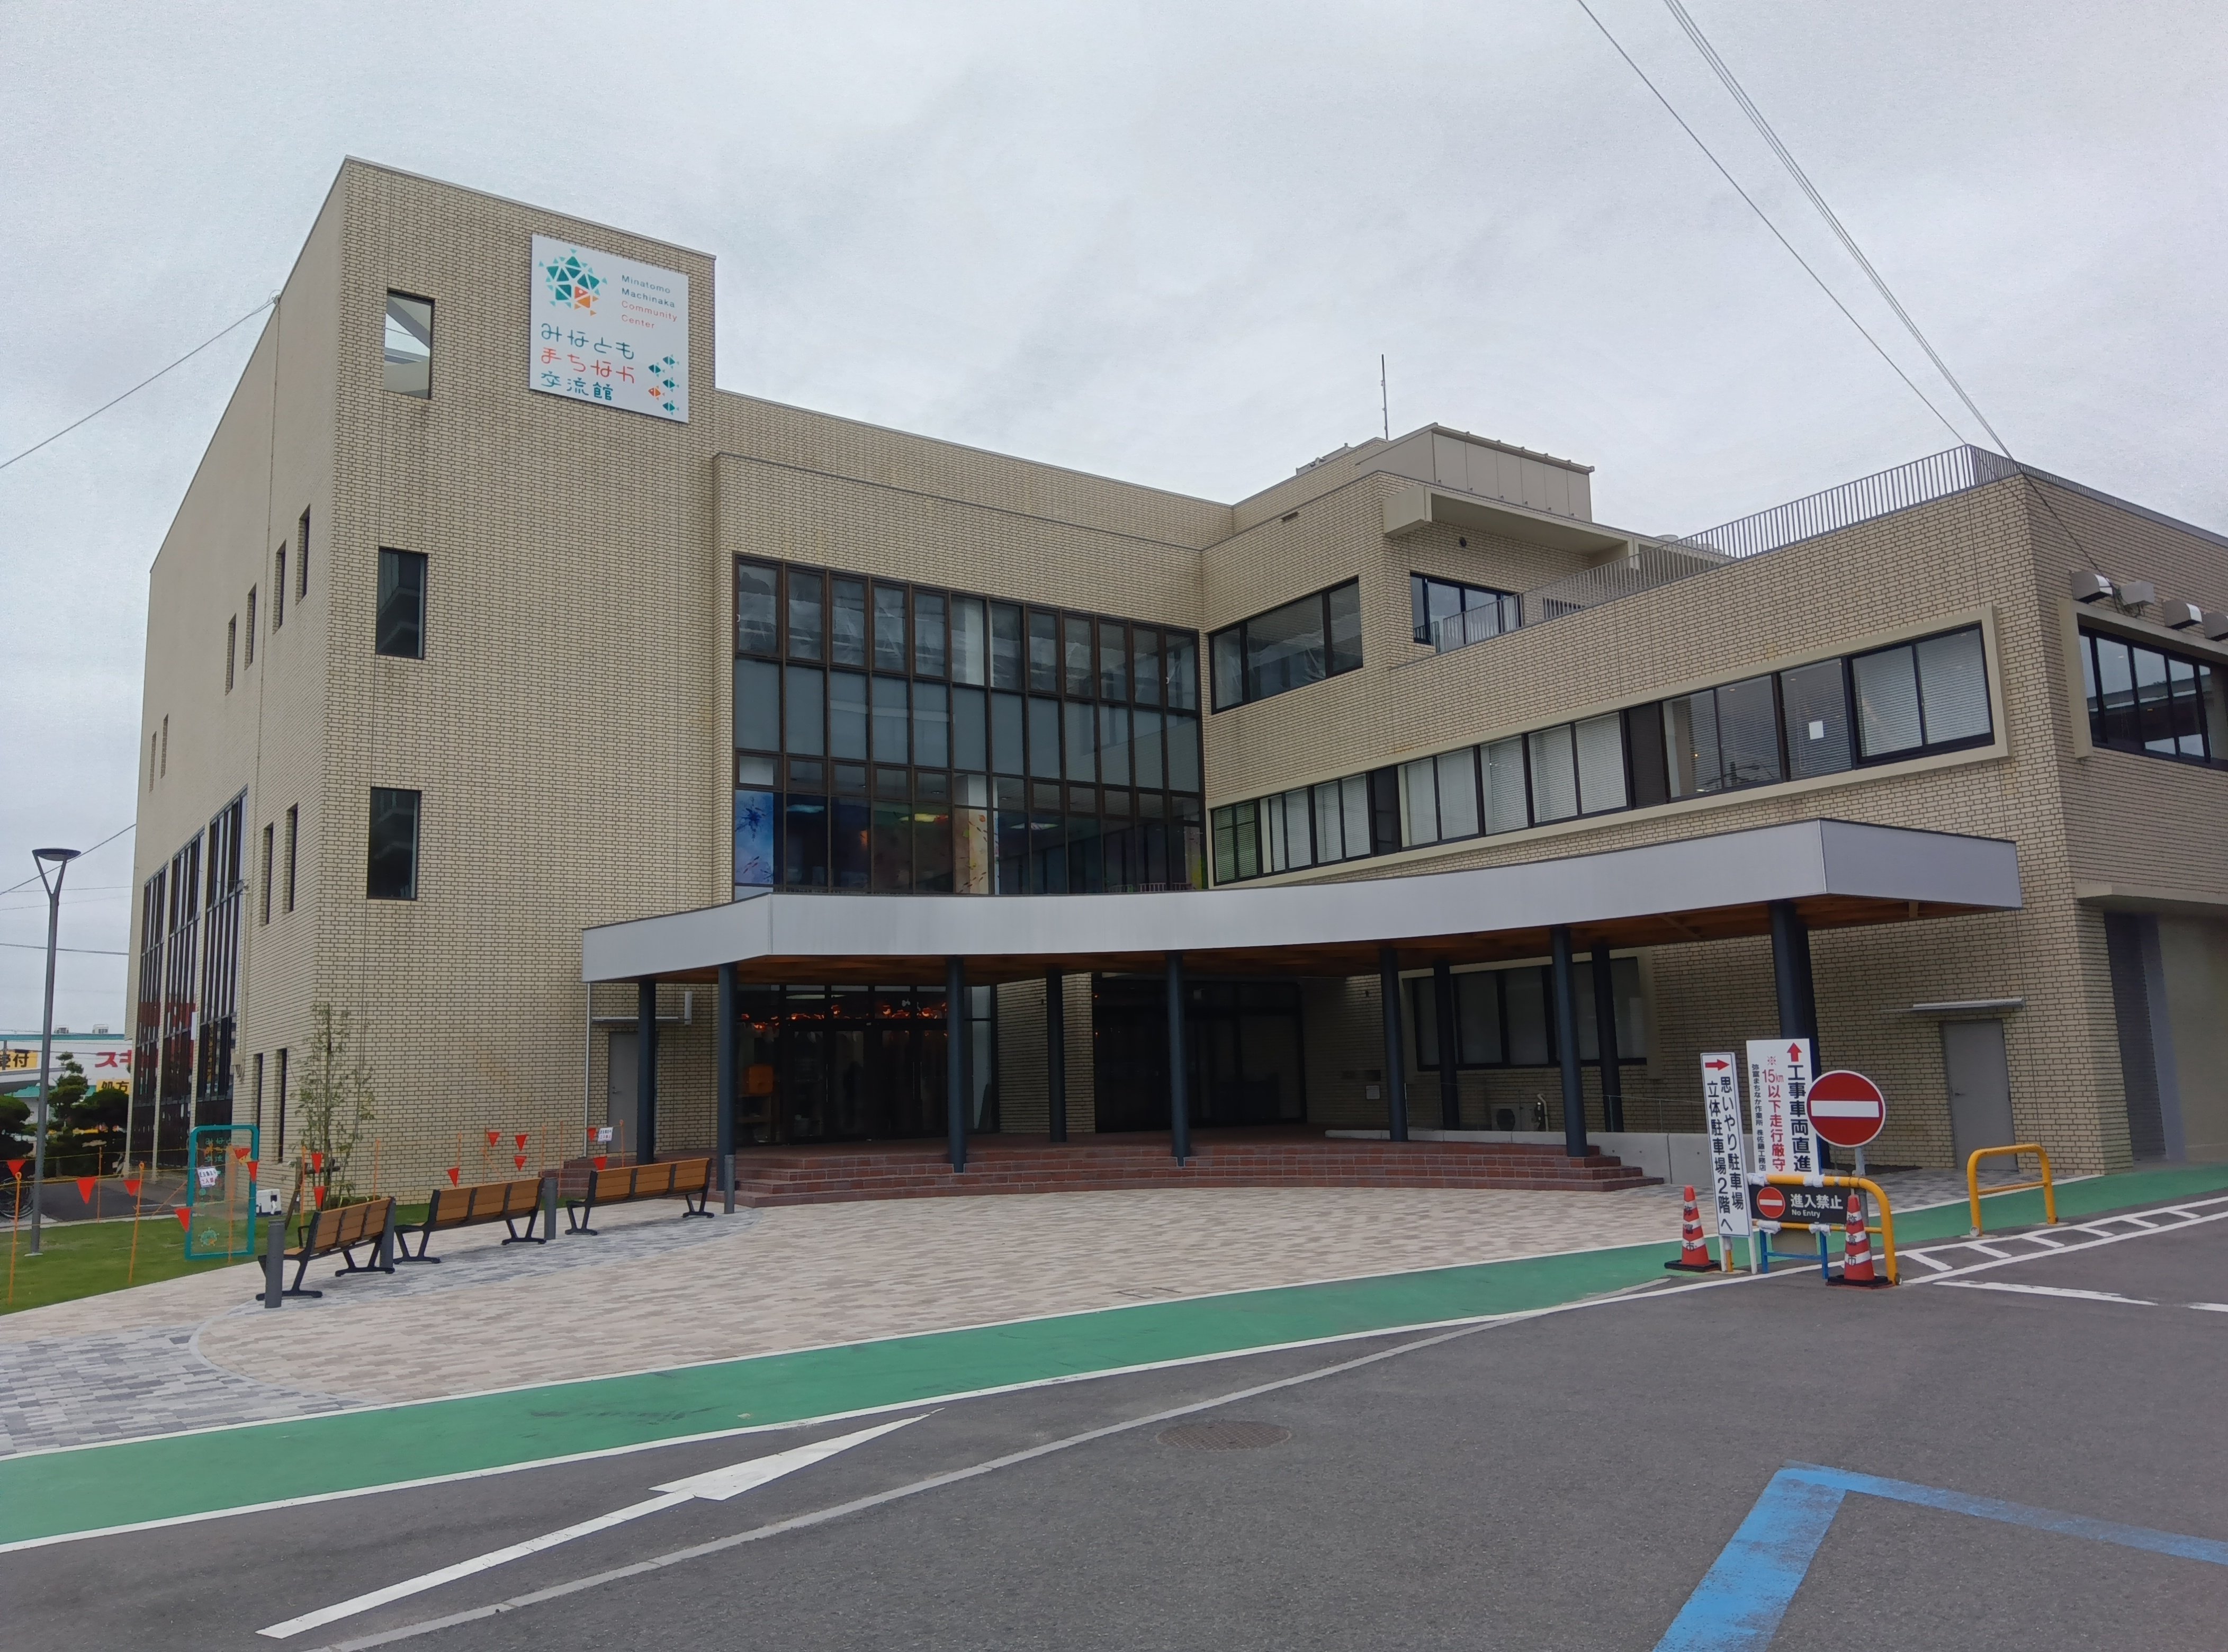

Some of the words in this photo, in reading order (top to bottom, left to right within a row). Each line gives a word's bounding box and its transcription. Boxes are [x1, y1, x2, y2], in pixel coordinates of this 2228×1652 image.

[622, 274, 671, 294] Minatomo
[621, 300, 678, 322] Community
[622, 288, 675, 308] Machinaka
[621, 314, 655, 329] Center
[541, 322, 635, 360] みなとも
[541, 347, 635, 384] まちなか
[541, 371, 614, 401] 交流館
[1787, 1065, 1812, 1172] 工事車両直進
[1720, 1076, 1744, 1210] 思いやり駐車場
[1707, 1081, 1733, 1232] 立体駐車場2階へ
[1790, 1193, 1844, 1209] 進入禁止
[1803, 1210, 1821, 1218] Entry
